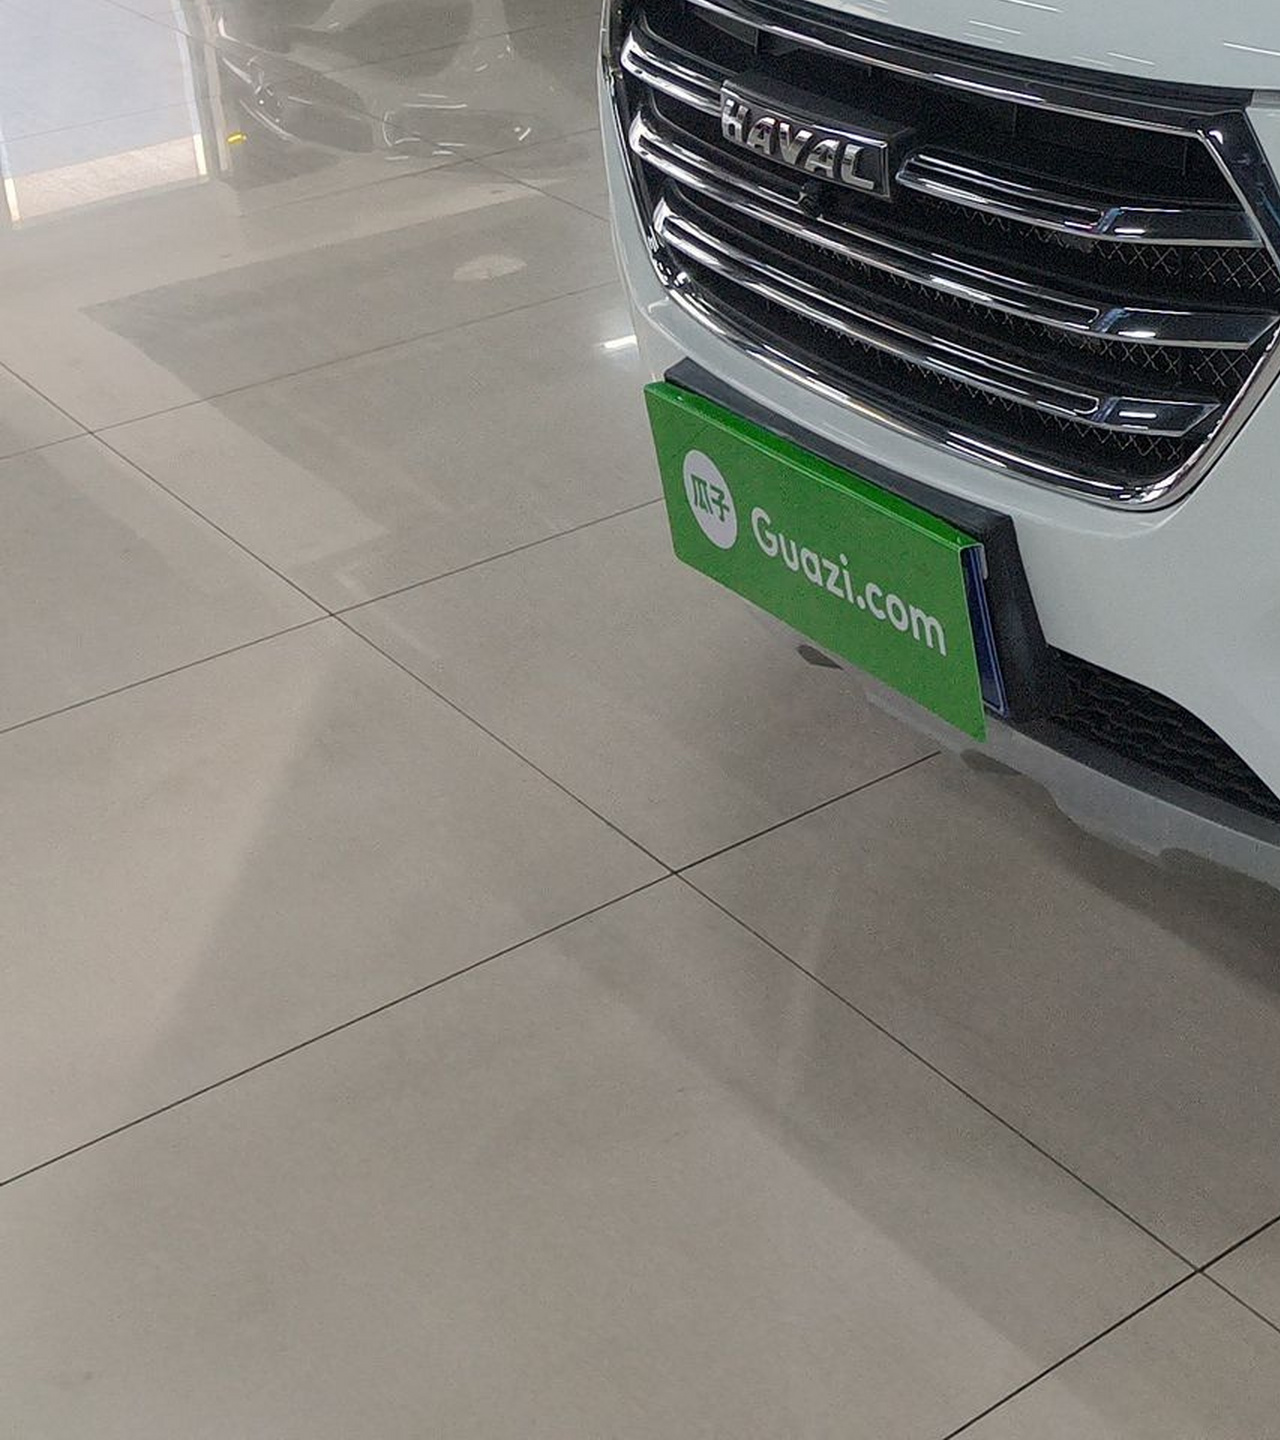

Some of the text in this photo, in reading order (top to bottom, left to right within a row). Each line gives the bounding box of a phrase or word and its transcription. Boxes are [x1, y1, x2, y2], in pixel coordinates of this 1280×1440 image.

[721, 99, 875, 190] HAVAL
[691, 473, 730, 522] 瓜子
[751, 506, 947, 656] Guazi.com
